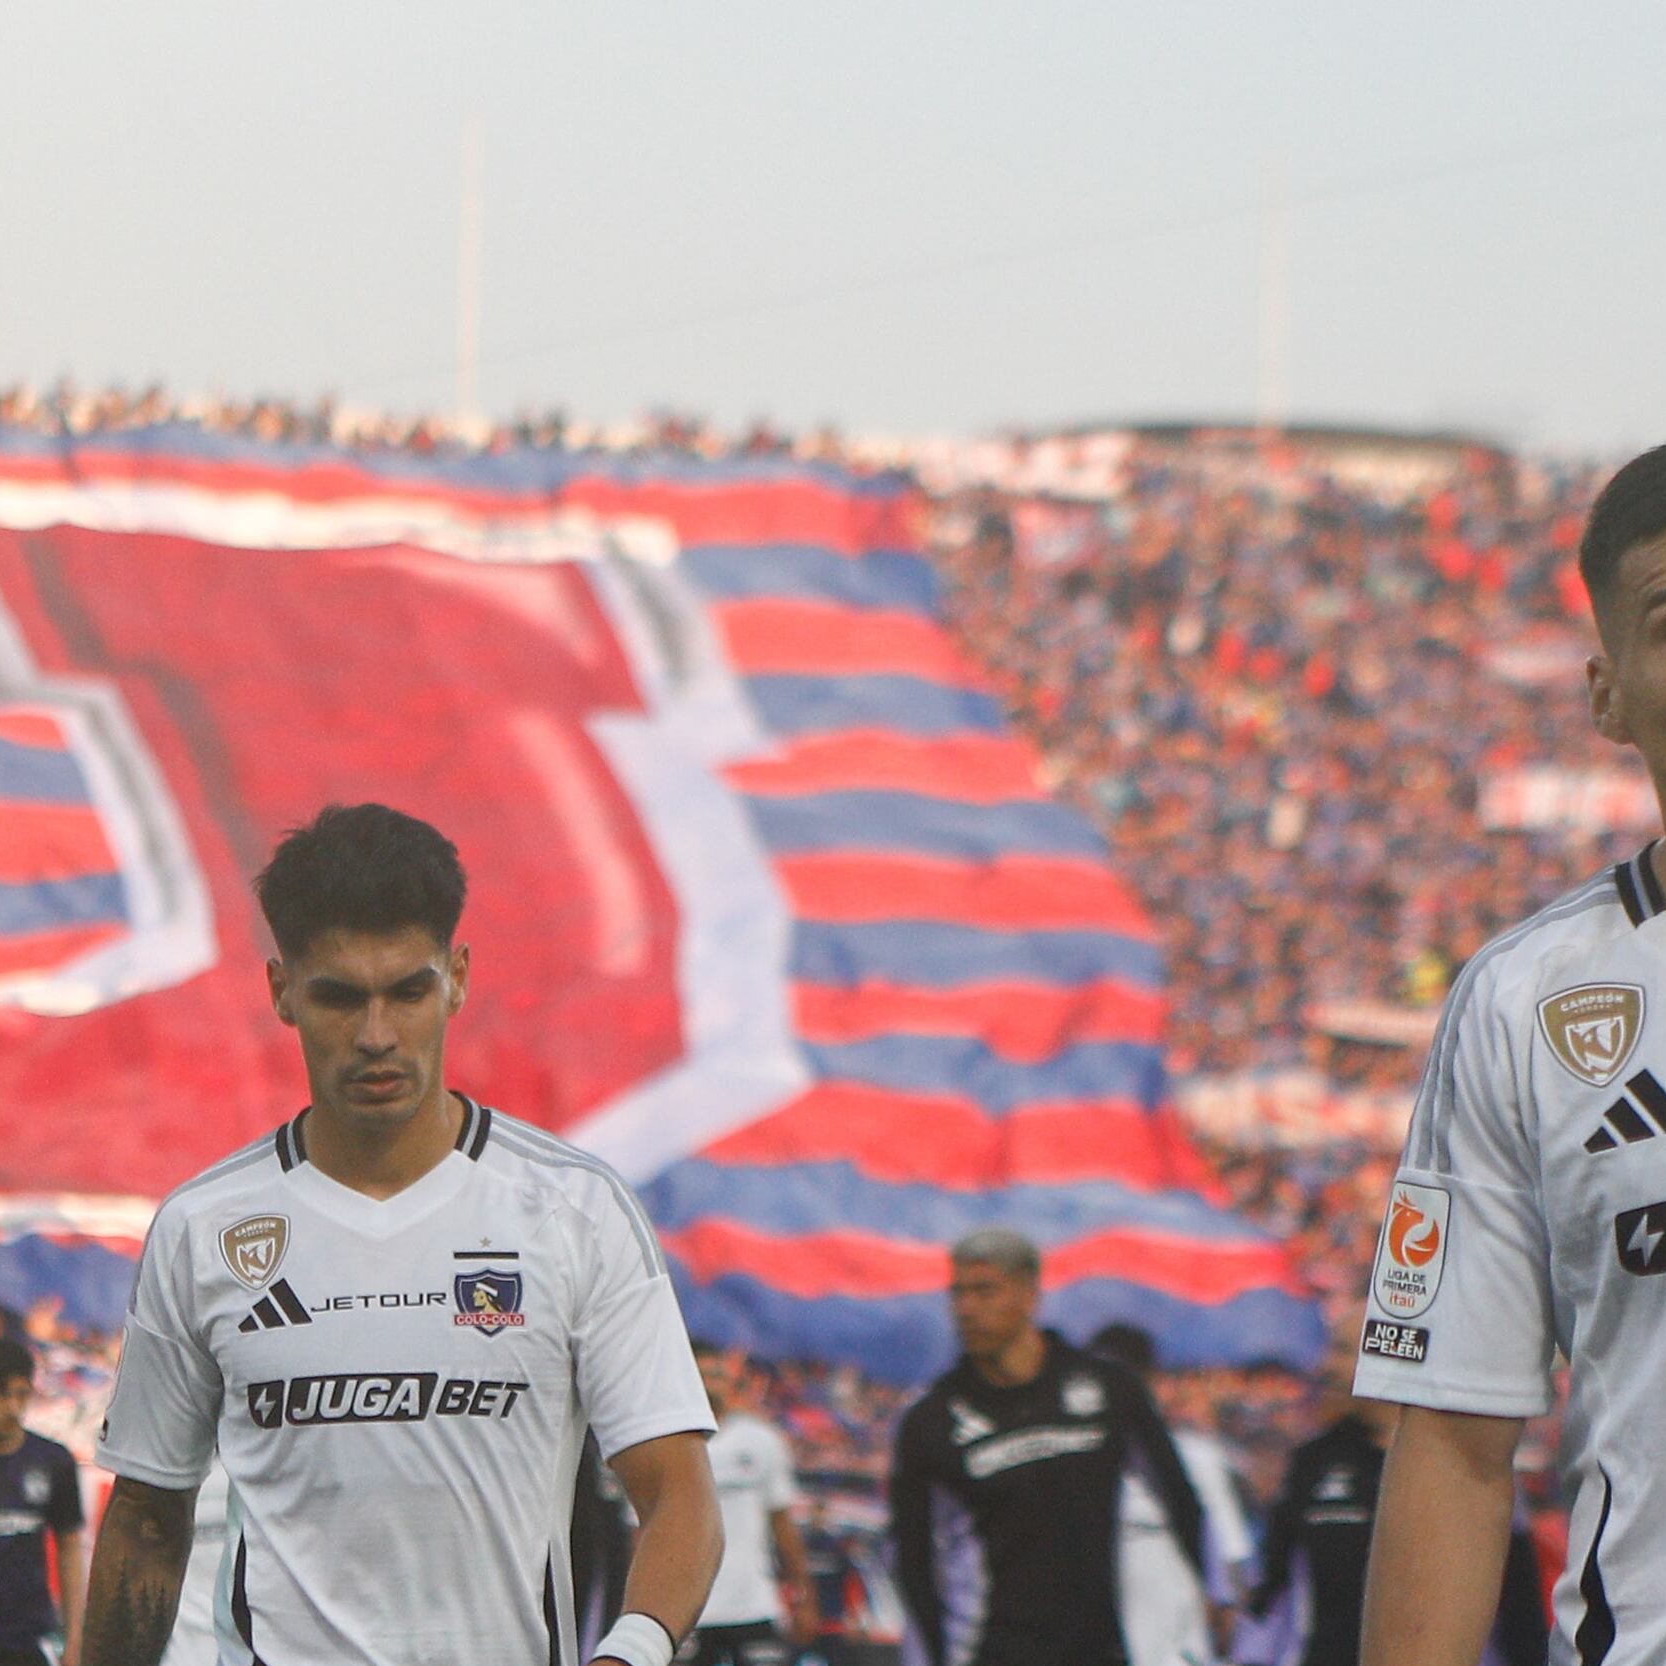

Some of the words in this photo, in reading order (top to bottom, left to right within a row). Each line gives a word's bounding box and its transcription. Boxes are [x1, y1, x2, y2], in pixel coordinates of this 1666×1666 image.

[1412, 1273, 1426, 1284] DE
[1382, 1280, 1426, 1296] PRIMERA
[311, 1293, 447, 1312] JETOUR
[455, 1313, 523, 1326] COLO-COLO
[1375, 1323, 1398, 1340] NO
[1400, 1328, 1417, 1344] SE
[1365, 1337, 1423, 1360] PELEEN
